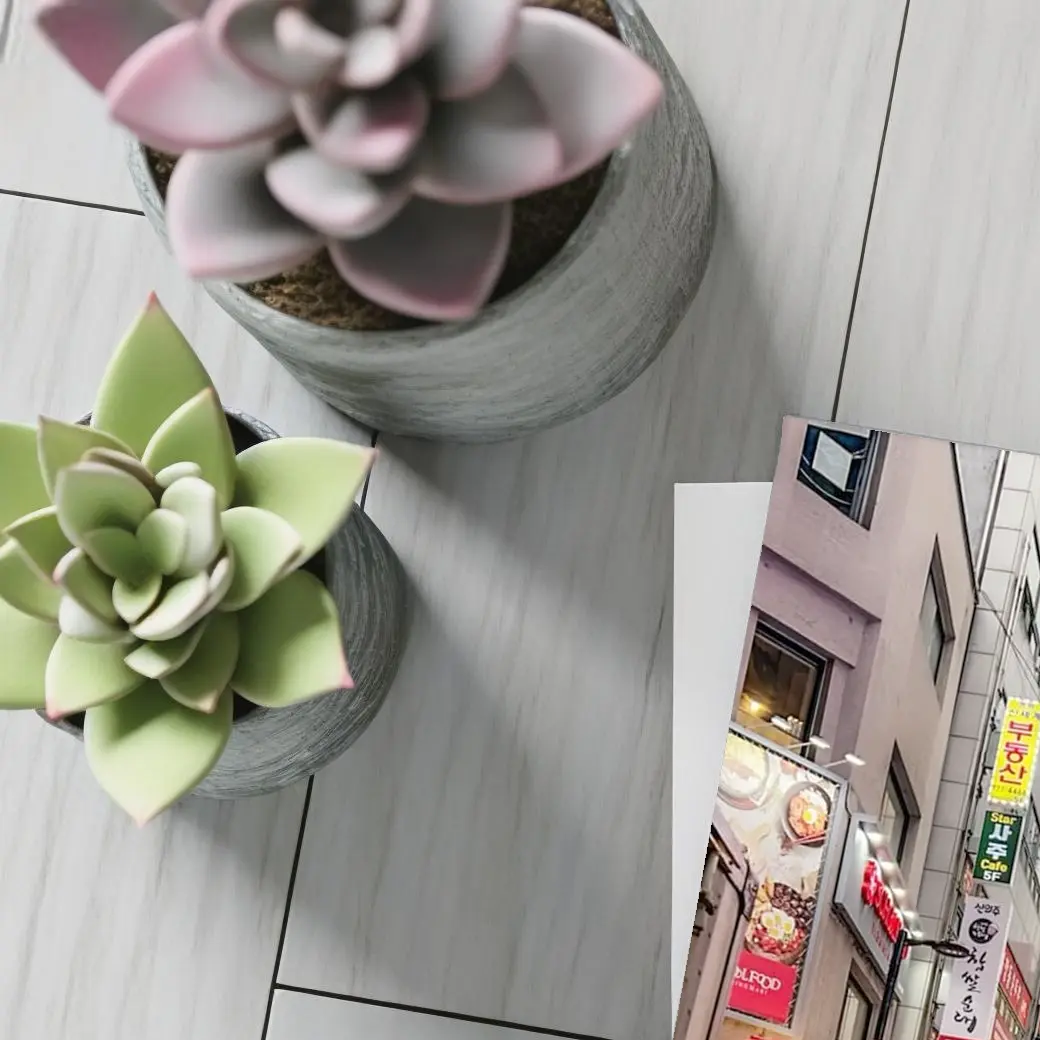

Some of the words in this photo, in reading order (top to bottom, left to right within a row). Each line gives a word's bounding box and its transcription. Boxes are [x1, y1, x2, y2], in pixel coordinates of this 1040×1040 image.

[999, 720, 1034, 786] 부동산
[990, 812, 1017, 825] Star
[986, 824, 1012, 860] 사주
[980, 859, 1008, 873] Cafe
[983, 871, 1001, 882] 5F
